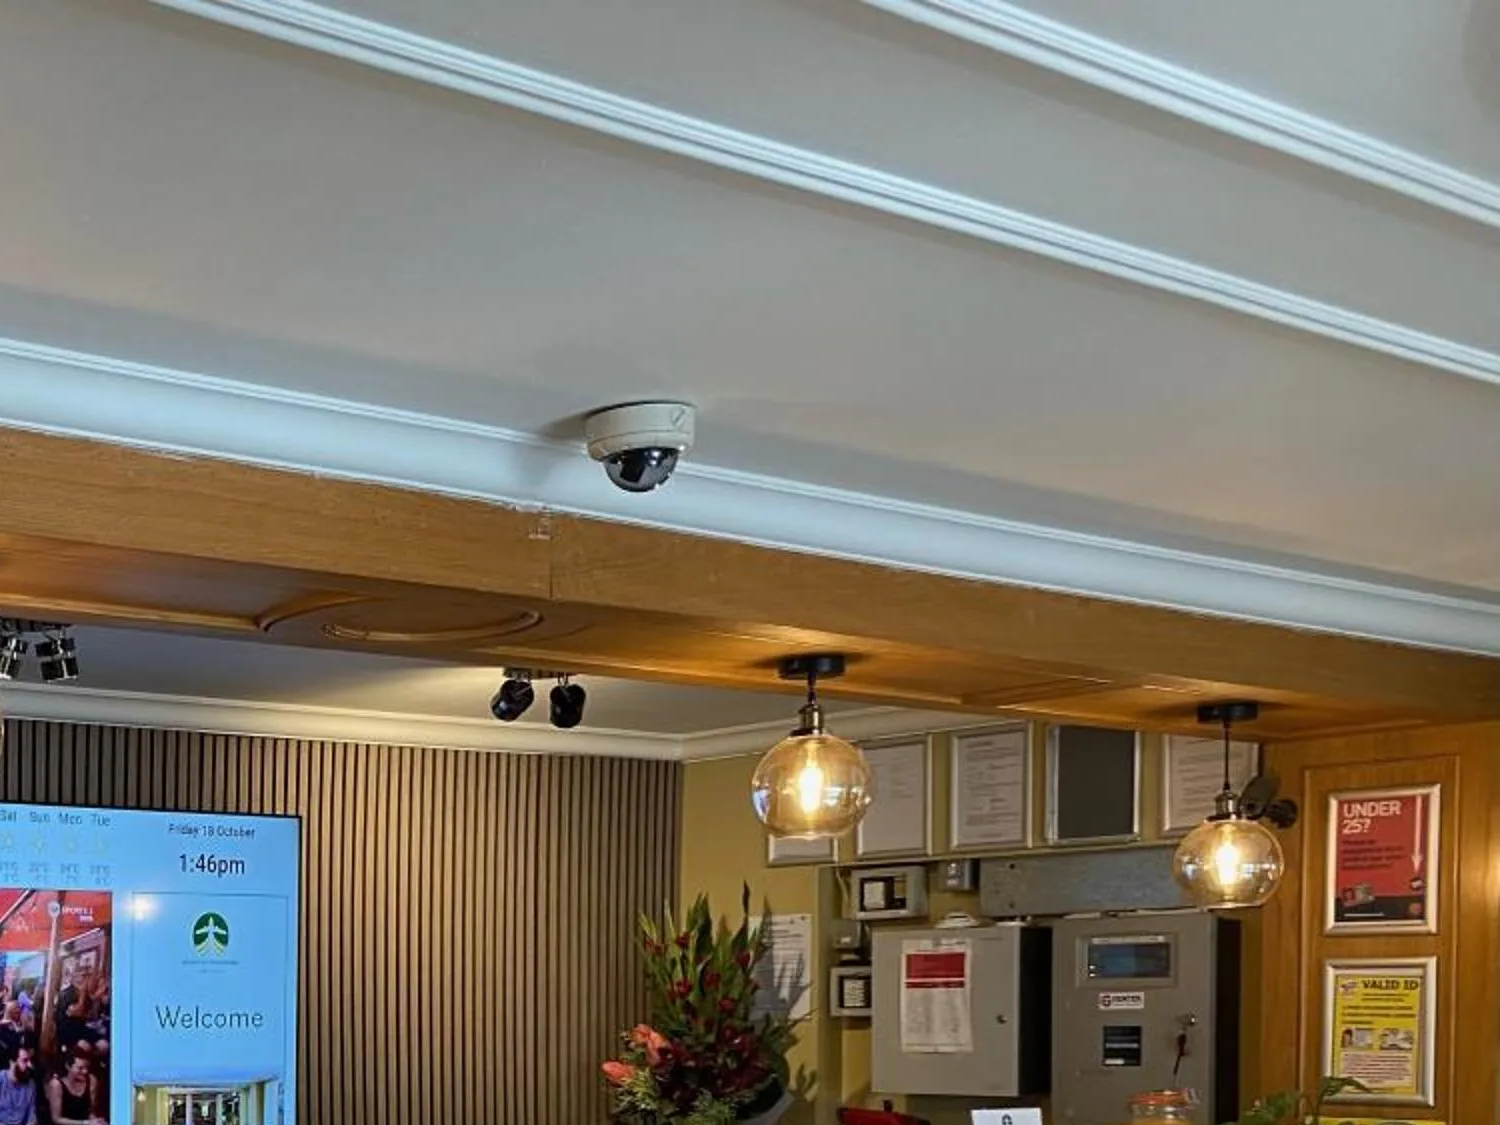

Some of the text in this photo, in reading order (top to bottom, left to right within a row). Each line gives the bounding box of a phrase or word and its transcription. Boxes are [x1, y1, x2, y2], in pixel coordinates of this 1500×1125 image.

[1343, 800, 1401, 818] UNDER
[91, 814, 111, 827] Tue
[1342, 819, 1371, 835] 25?
[203, 825, 215, 836] 18
[218, 826, 255, 839] October
[180, 853, 246, 878] 1:46pm
[1361, 980, 1419, 990] VALID ID
[155, 1005, 264, 1029] Welcome
